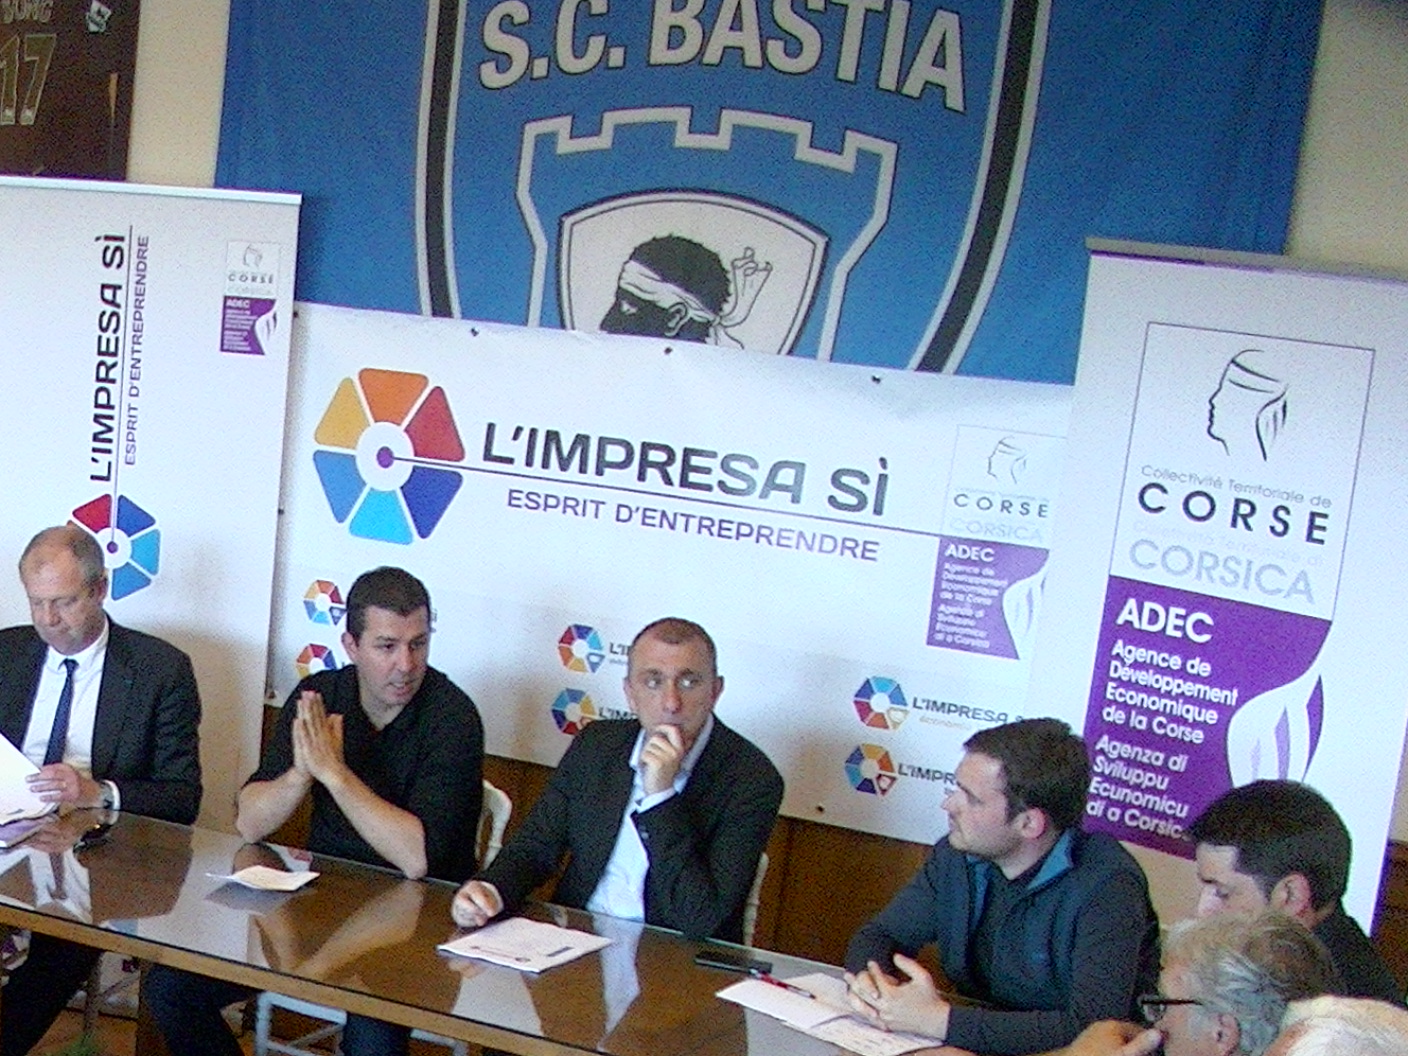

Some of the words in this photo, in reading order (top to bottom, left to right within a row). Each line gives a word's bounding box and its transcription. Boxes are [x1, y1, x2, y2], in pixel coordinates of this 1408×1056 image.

[479, 0, 626, 89] S.C.
[648, 0, 967, 113] BASTIA
[129, 235, 149, 397] D'ENTREPRENDRE
[90, 283, 122, 482] L'IMPRESA
[125, 403, 139, 466] ESPRIT
[482, 422, 807, 504] L'IMPRESA
[827, 456, 889, 517] SÌ
[1141, 464, 1224, 489] Collectivité
[1229, 479, 1305, 504] Territoriale
[1310, 494, 1333, 509] de
[507, 489, 606, 520] ESPRIT
[615, 503, 880, 562] D'ENTREPRENDRE
[953, 493, 1049, 518] CORSE
[1138, 482, 1330, 546] CORSE
[944, 543, 995, 563] ADEC
[1129, 538, 1316, 604] CORSICA
[1116, 598, 1214, 644] ADEC
[1111, 639, 1182, 670] Agence
[1186, 657, 1212, 677] de
[912, 696, 1009, 725] L'IMPRESA
[1102, 705, 1126, 725] de
[1129, 710, 1148, 731] la
[1151, 716, 1205, 744] Corse
[1105, 682, 1219, 725] Economique
[898, 763, 957, 787] L'IMPR
[1093, 755, 1170, 791] Sviluppu
[1095, 734, 1165, 767] Agenza
[1168, 753, 1190, 773] di
[1086, 800, 1106, 818] di
[1089, 776, 1191, 819] Ecunomicu
